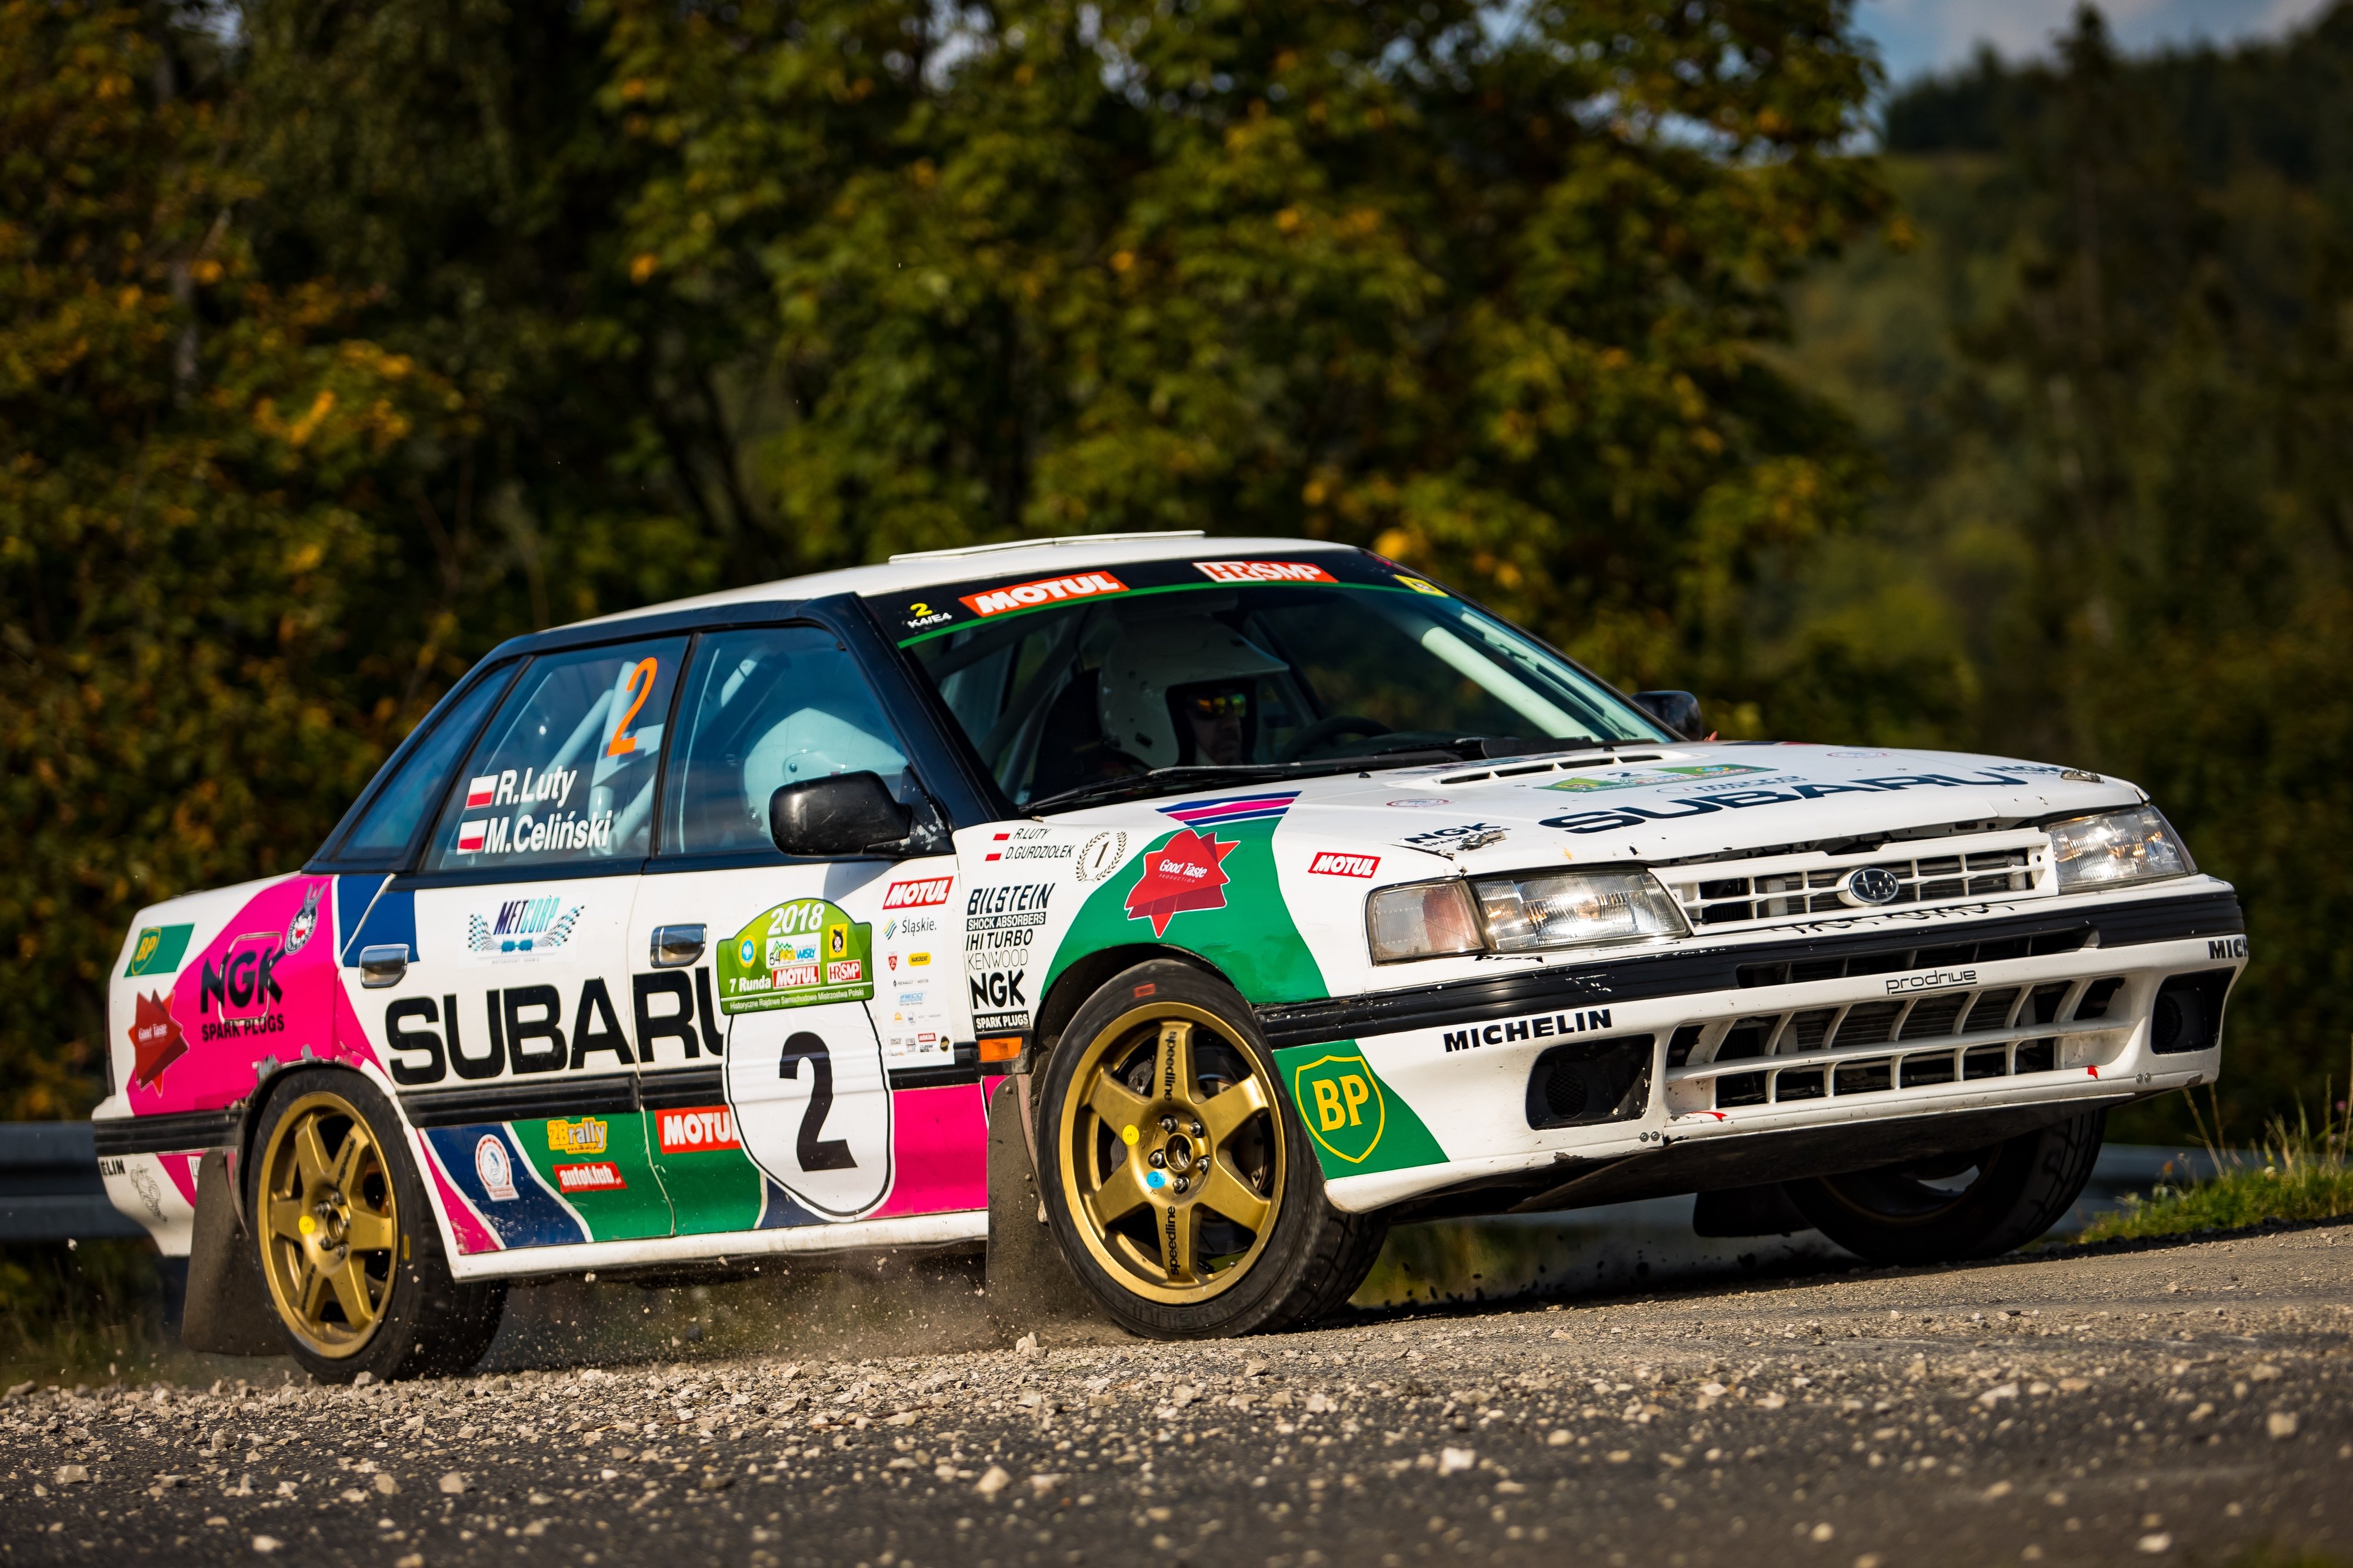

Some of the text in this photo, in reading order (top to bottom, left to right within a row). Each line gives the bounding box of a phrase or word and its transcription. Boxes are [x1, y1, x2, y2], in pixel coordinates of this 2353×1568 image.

[974, 574, 1119, 614] MOTUL
[910, 603, 933, 618] 2
[607, 657, 658, 756] 2
[495, 766, 577, 808] R.Luty
[1538, 771, 2029, 834] SUBARU
[484, 810, 613, 854] M.Celiński
[1014, 828, 1051, 840] R.LUTY
[1404, 823, 1501, 844] NGK
[1005, 845, 1075, 859] D.GURDZIOŁEK
[1092, 841, 1109, 868] 1
[1314, 855, 1375, 876] MOTUL
[1158, 873, 1196, 883] PRODUCTION
[1159, 859, 1208, 878] Good Taste
[884, 880, 949, 906] MOTUL
[967, 883, 1056, 916] BILSTEIN
[493, 897, 561, 936] METCORP
[766, 902, 825, 936] 2018
[901, 916, 936, 936] Śląskie.
[968, 913, 1044, 930] SHOCK ABSORBERS
[135, 935, 158, 962] BP
[965, 928, 1034, 951] IHI TURBO
[828, 963, 860, 981] HRSMP
[968, 949, 1029, 970] KENWOOD
[200, 946, 286, 1014] NGK
[729, 975, 772, 993] 7 Runda
[775, 966, 818, 987] MOTUL
[969, 969, 1026, 1009] NGK
[1885, 969, 1978, 995] prodrive
[730, 1001, 759, 1011] Historyczne
[818, 990, 848, 1000] Mistrzostwa
[848, 987, 865, 997] Polski
[202, 1014, 285, 1042] SPARK PLUGS
[976, 1013, 1029, 1029] SPARK PLUGS
[1443, 1008, 1612, 1053] MICHELIN
[1164, 1030, 1177, 1102] speedline
[779, 1030, 858, 1172] 2
[1312, 1074, 1369, 1132] BP
[548, 1120, 605, 1149] 2Brally
[1165, 1205, 1181, 1276] speedline
